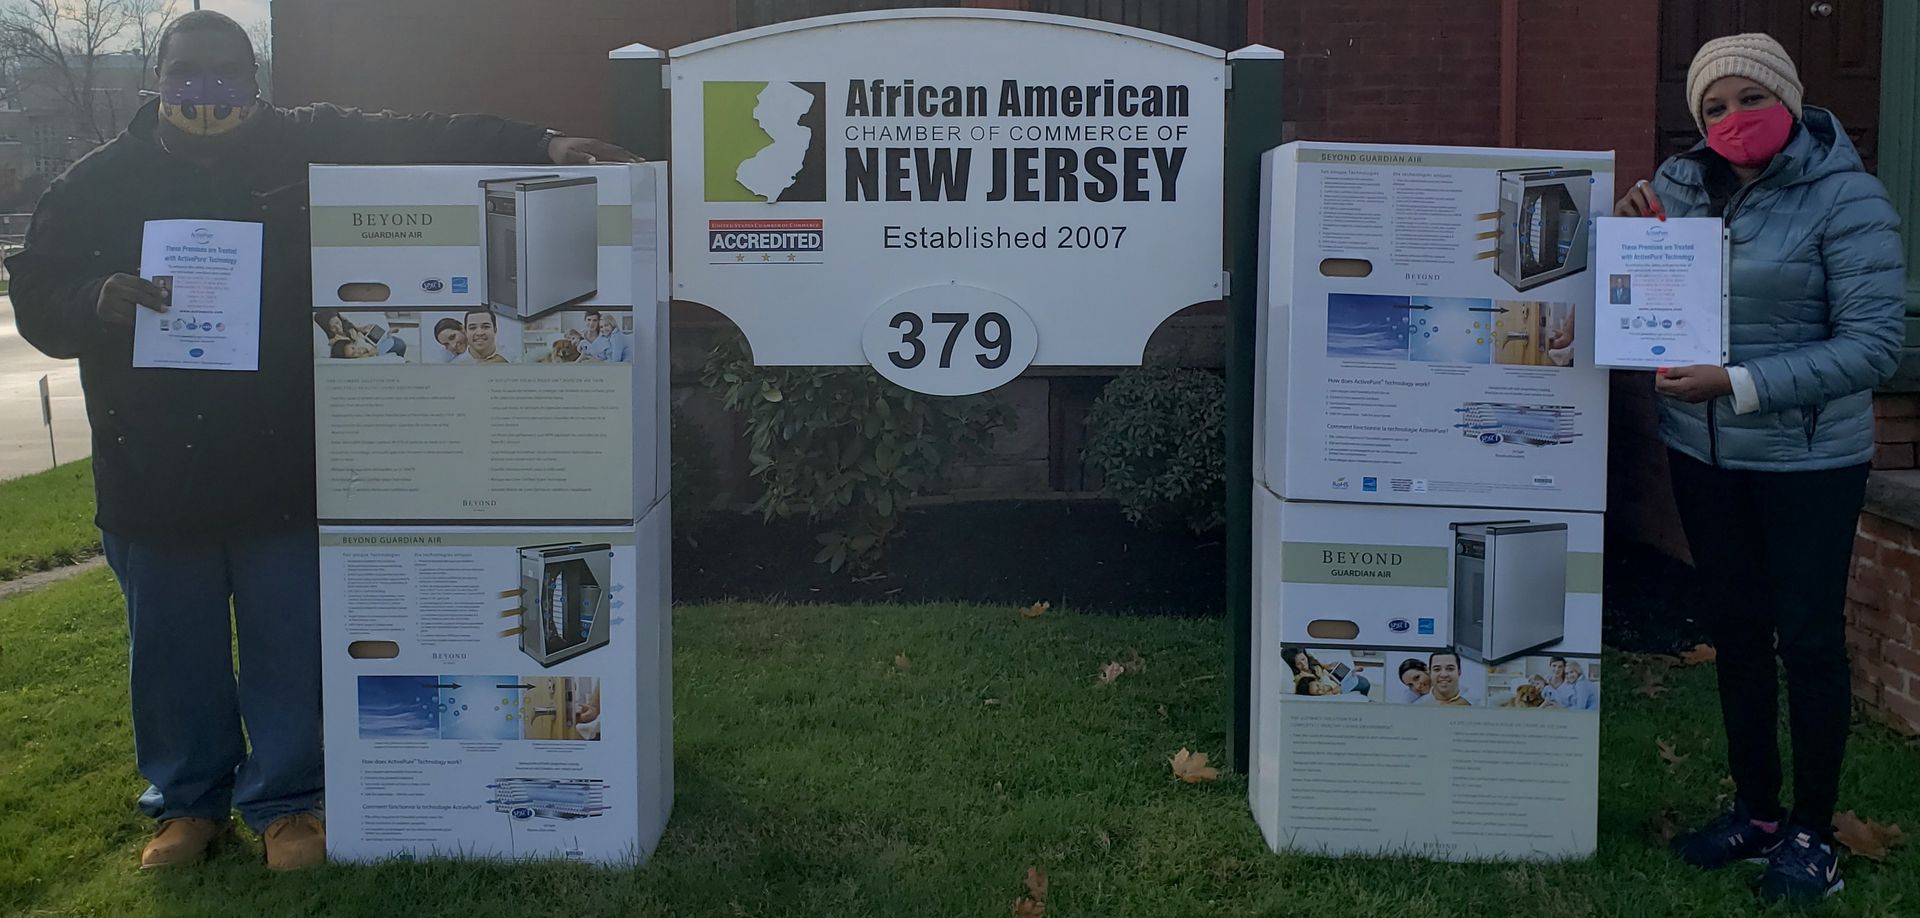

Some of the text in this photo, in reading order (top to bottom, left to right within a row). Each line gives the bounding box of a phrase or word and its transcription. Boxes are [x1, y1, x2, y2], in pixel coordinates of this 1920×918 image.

[846, 79, 1188, 117] African American
[846, 126, 1187, 141] CHAMBER OF COMMERCE OF
[1321, 153, 1423, 164] BEYOND GUARDIAN AIR
[845, 147, 1187, 202] NEW JERSEY
[353, 213, 432, 226] BEYOND
[711, 232, 820, 250] ACCREDITED
[885, 226, 1126, 248] Established 2007
[1405, 273, 1440, 281] BEYOND
[888, 312, 1011, 369] 379
[342, 536, 442, 544] BEYOND GUARDIAN AIR
[1322, 550, 1402, 566] BEYOND
[1331, 568, 1391, 578] GUARDIAN AIR
